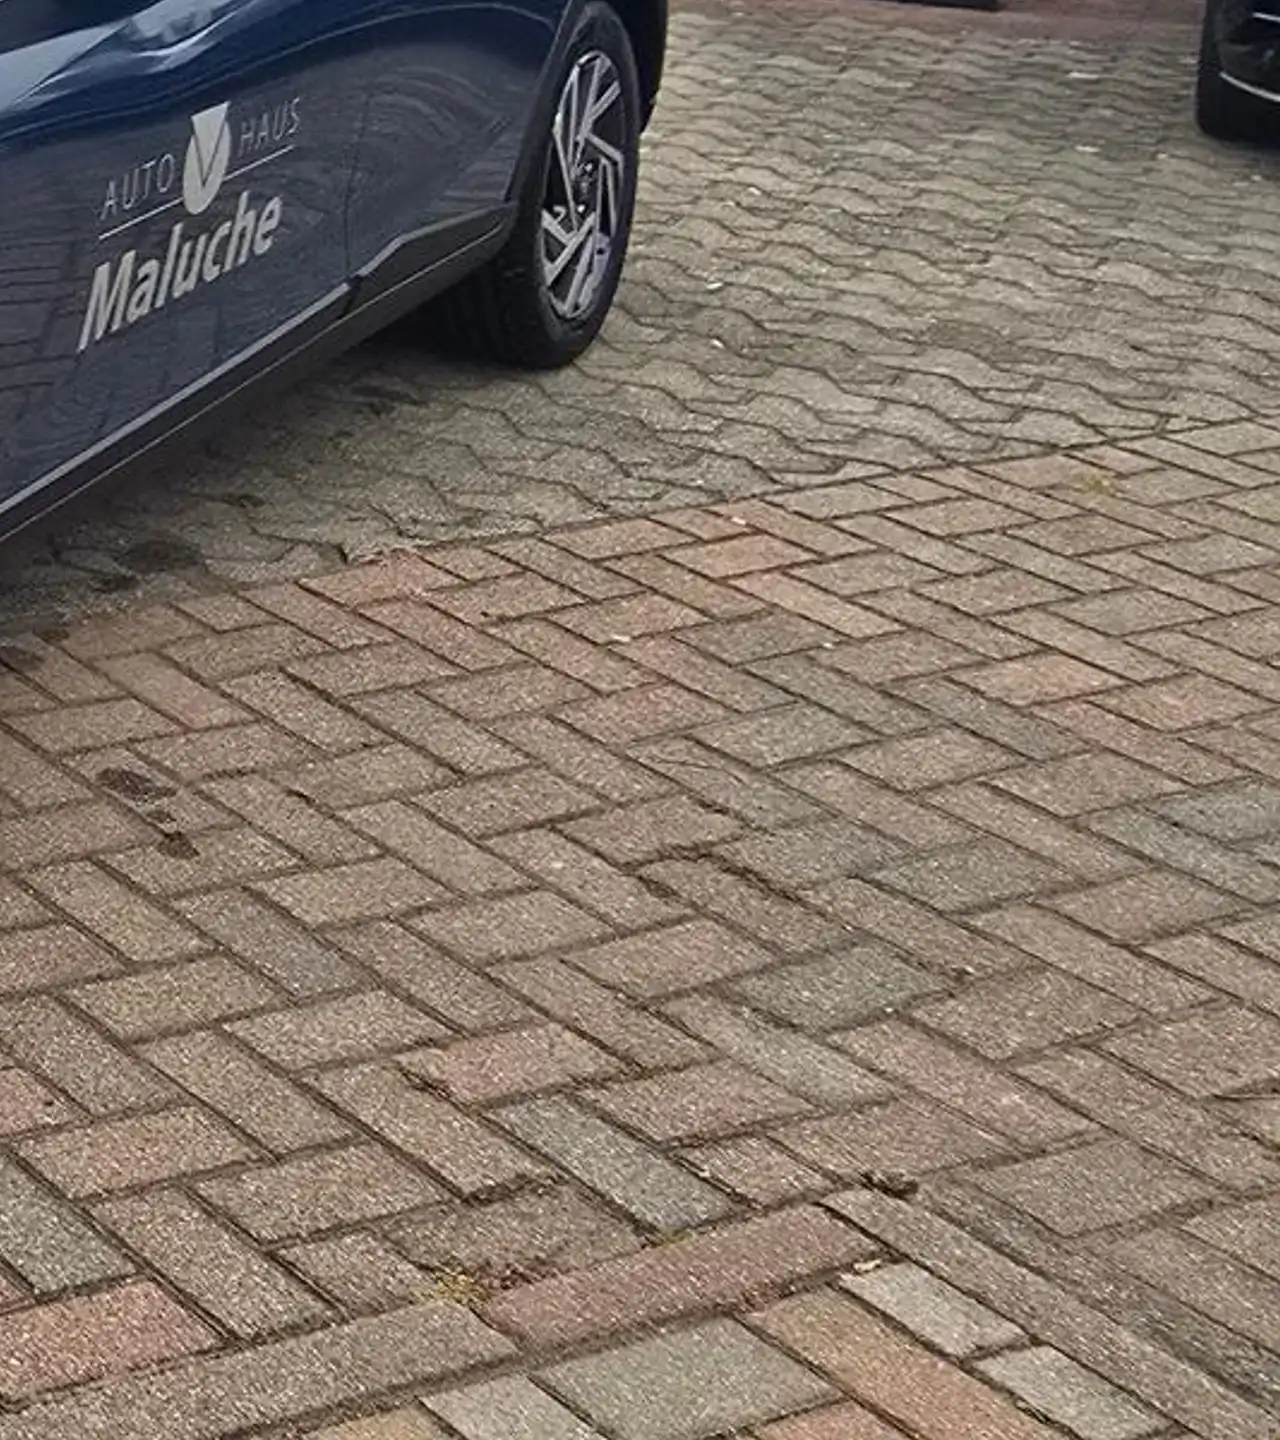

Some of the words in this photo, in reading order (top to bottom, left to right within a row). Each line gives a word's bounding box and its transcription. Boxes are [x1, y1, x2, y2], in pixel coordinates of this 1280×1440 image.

[98, 153, 175, 221] AUTO
[241, 97, 301, 152] HAUS
[77, 189, 283, 353] Maluche
